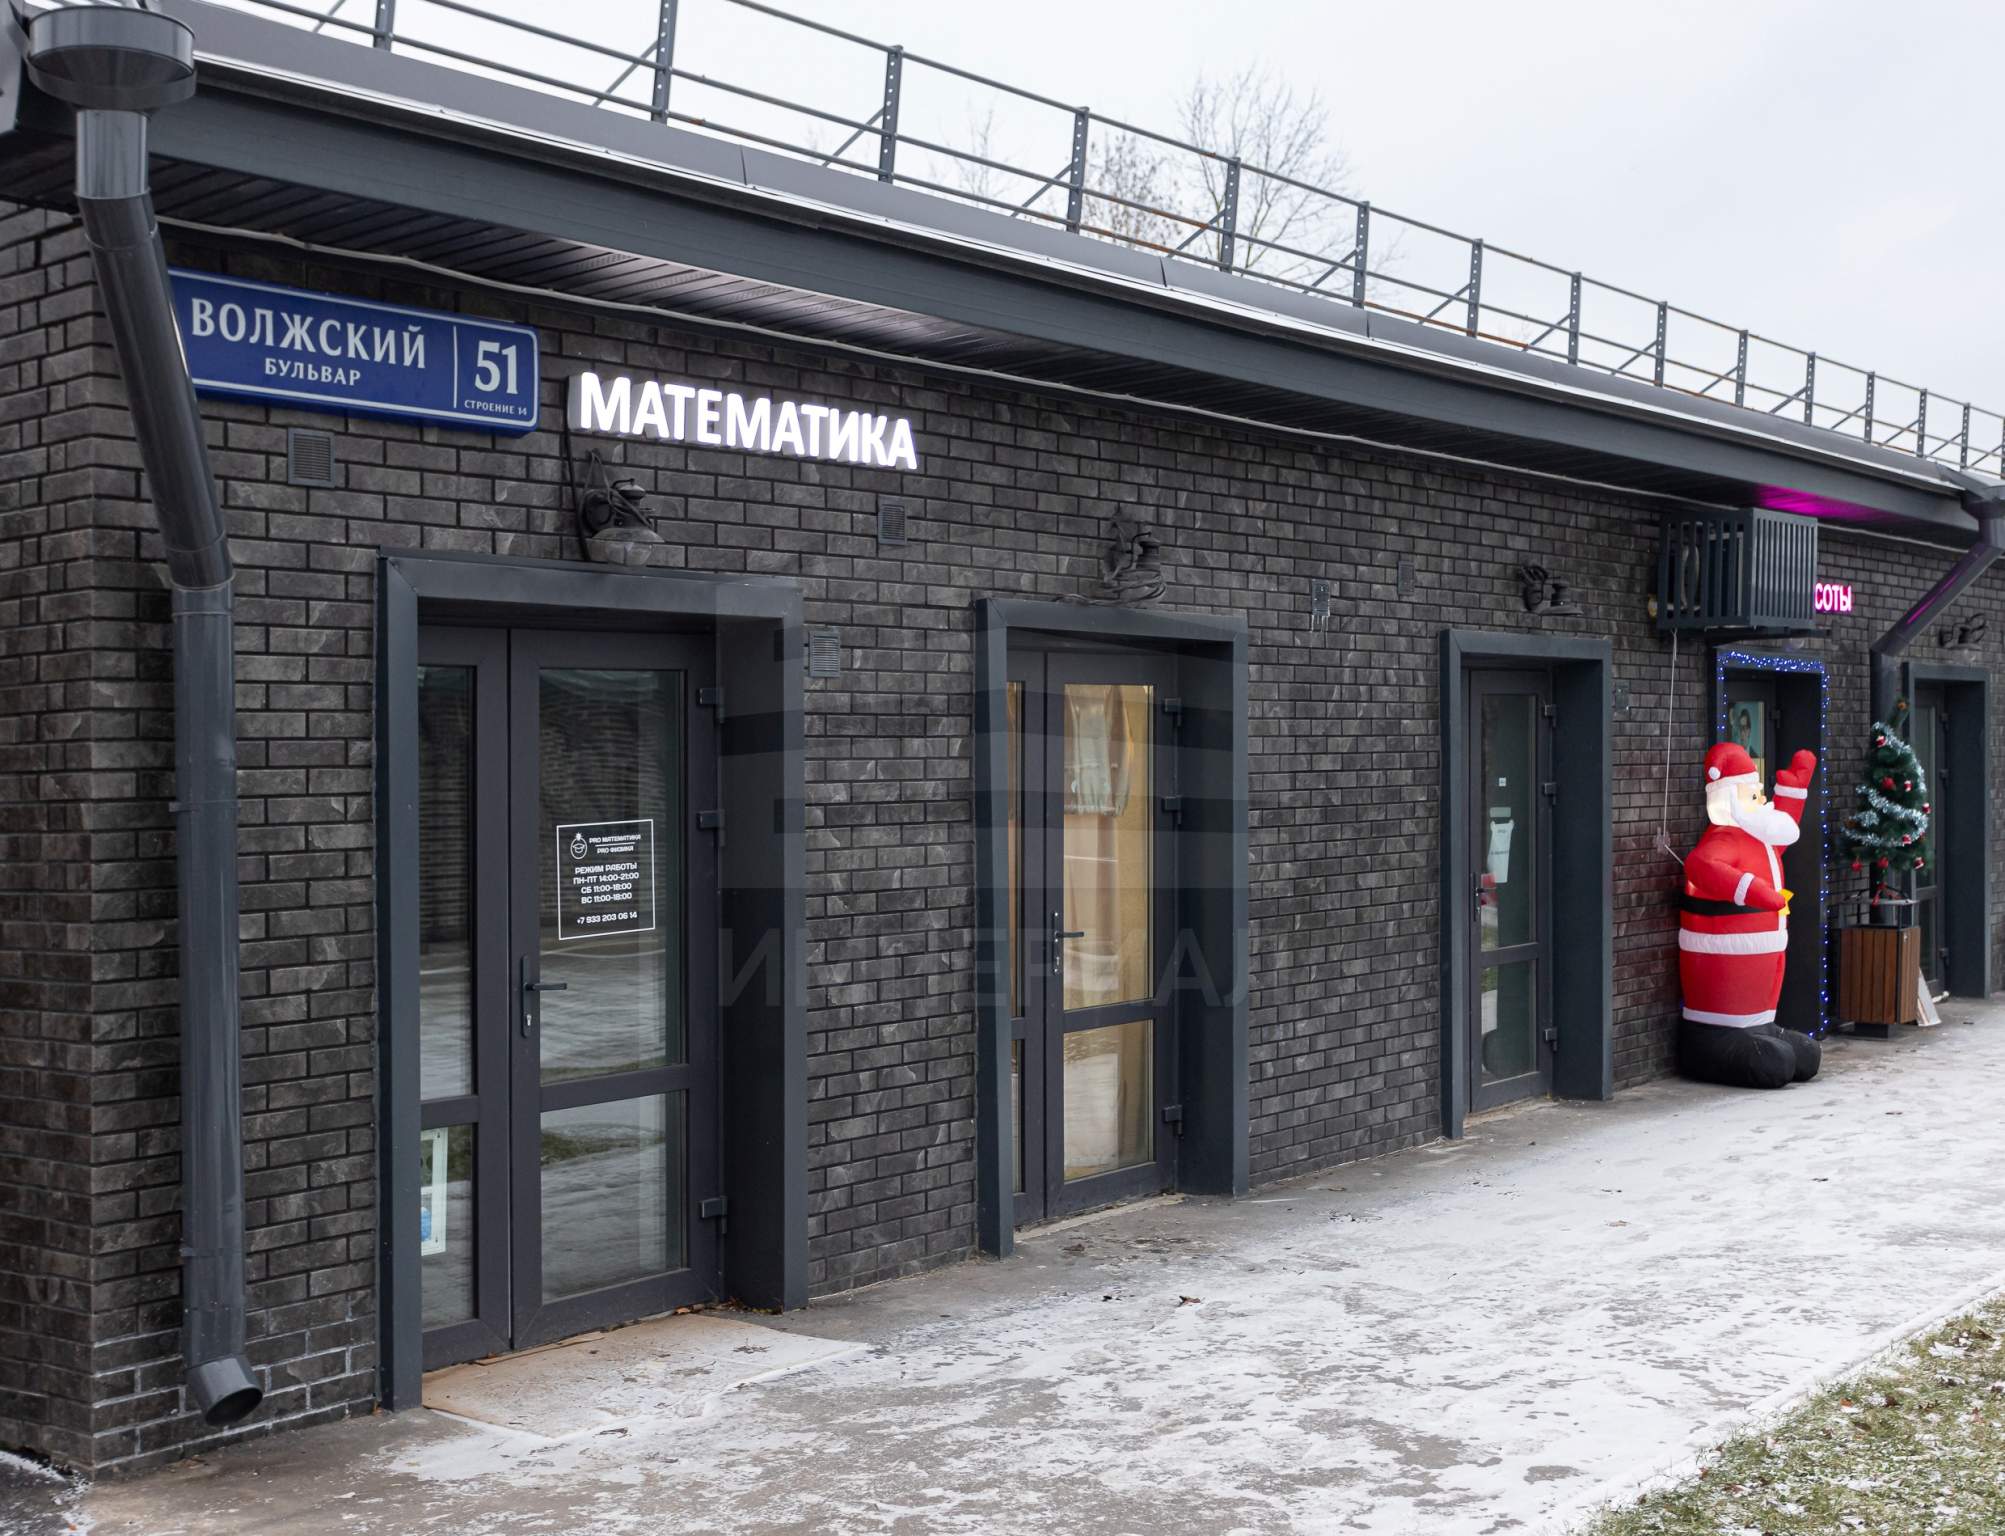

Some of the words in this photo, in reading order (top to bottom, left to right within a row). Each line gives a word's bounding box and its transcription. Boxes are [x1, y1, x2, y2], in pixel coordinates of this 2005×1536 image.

[191, 297, 426, 369] ВОЛЖСКИЙ
[264, 357, 361, 387] БУЛЬВАР
[474, 340, 519, 395] 51
[464, 399, 515, 415] СТРОЕНИЕ
[517, 406, 528, 416] 14
[580, 371, 918, 470] МАТЕМАТИКА
[1814, 582, 1852, 612] СОТЫ
[575, 865, 604, 874] РЕЖИМ
[605, 862, 637, 871] РАБОТЫ
[573, 875, 598, 885] ПН-ПТ
[599, 872, 640, 882] 14:00-21:00
[581, 886, 592, 894] СБ
[581, 896, 592, 904] ВС
[602, 913, 617, 922] 203
